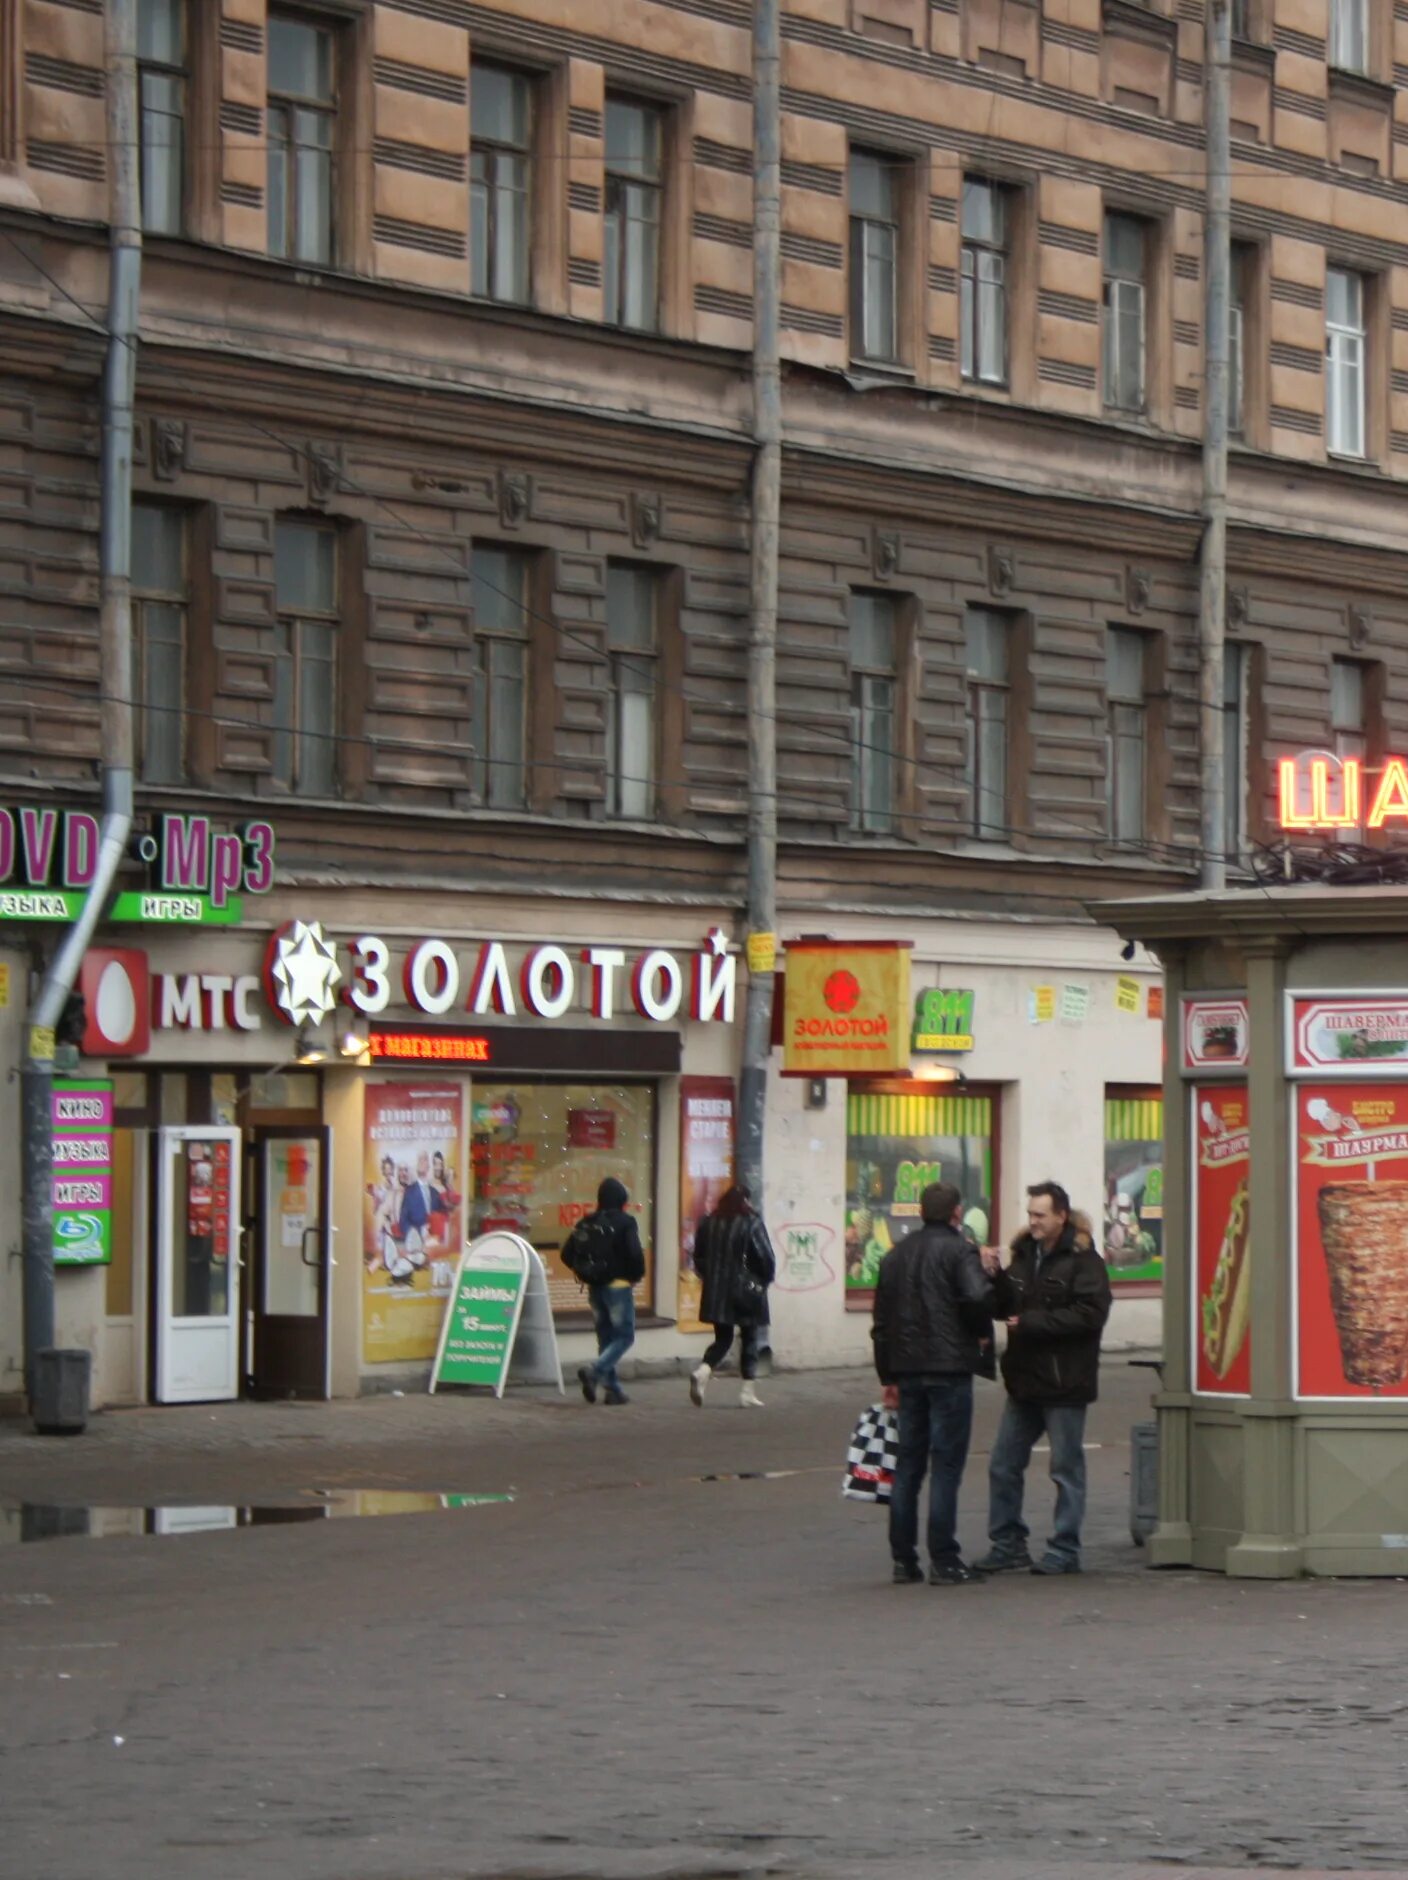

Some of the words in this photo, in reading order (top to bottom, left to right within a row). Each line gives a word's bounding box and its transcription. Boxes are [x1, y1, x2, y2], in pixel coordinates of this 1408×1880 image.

[161, 814, 275, 907] Mp3
[141, 896, 203, 920] ИГРЫ
[344, 927, 737, 1023] ЗОЛОТОЙ
[155, 973, 262, 1031] МТС
[794, 1014, 889, 1036] ЗОЛОТОЙ
[56, 1099, 103, 1119] КИНО
[1333, 1134, 1408, 1158] ШАУРМА
[55, 1182, 103, 1203] ИГРЫ
